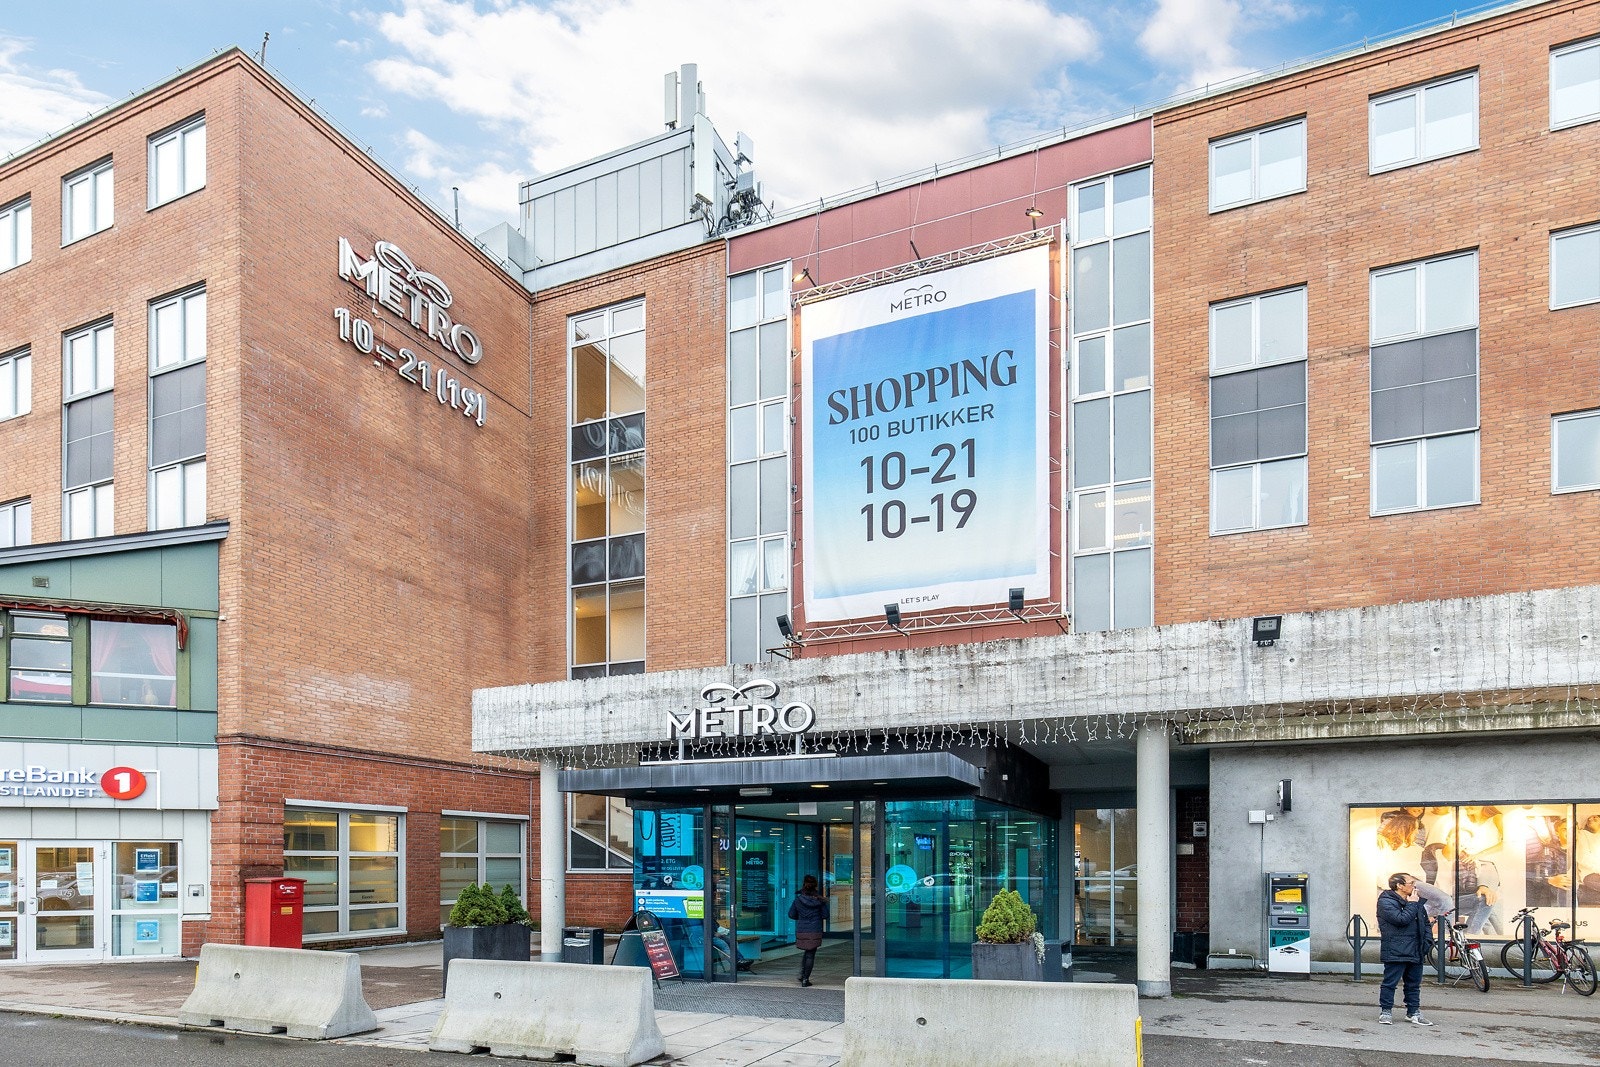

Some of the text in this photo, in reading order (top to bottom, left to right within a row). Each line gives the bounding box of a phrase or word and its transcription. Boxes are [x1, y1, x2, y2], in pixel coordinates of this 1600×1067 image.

[338, 236, 483, 365] METRO
[890, 290, 947, 313] METRO
[436, 369, 487, 427] (19)
[827, 349, 1018, 426] SHOPPING
[849, 403, 995, 445] 100 BUTIKKER
[922, 594, 940, 603] PLAY
[666, 701, 816, 740] METRO
[0, 765, 132, 794] reBank 1
